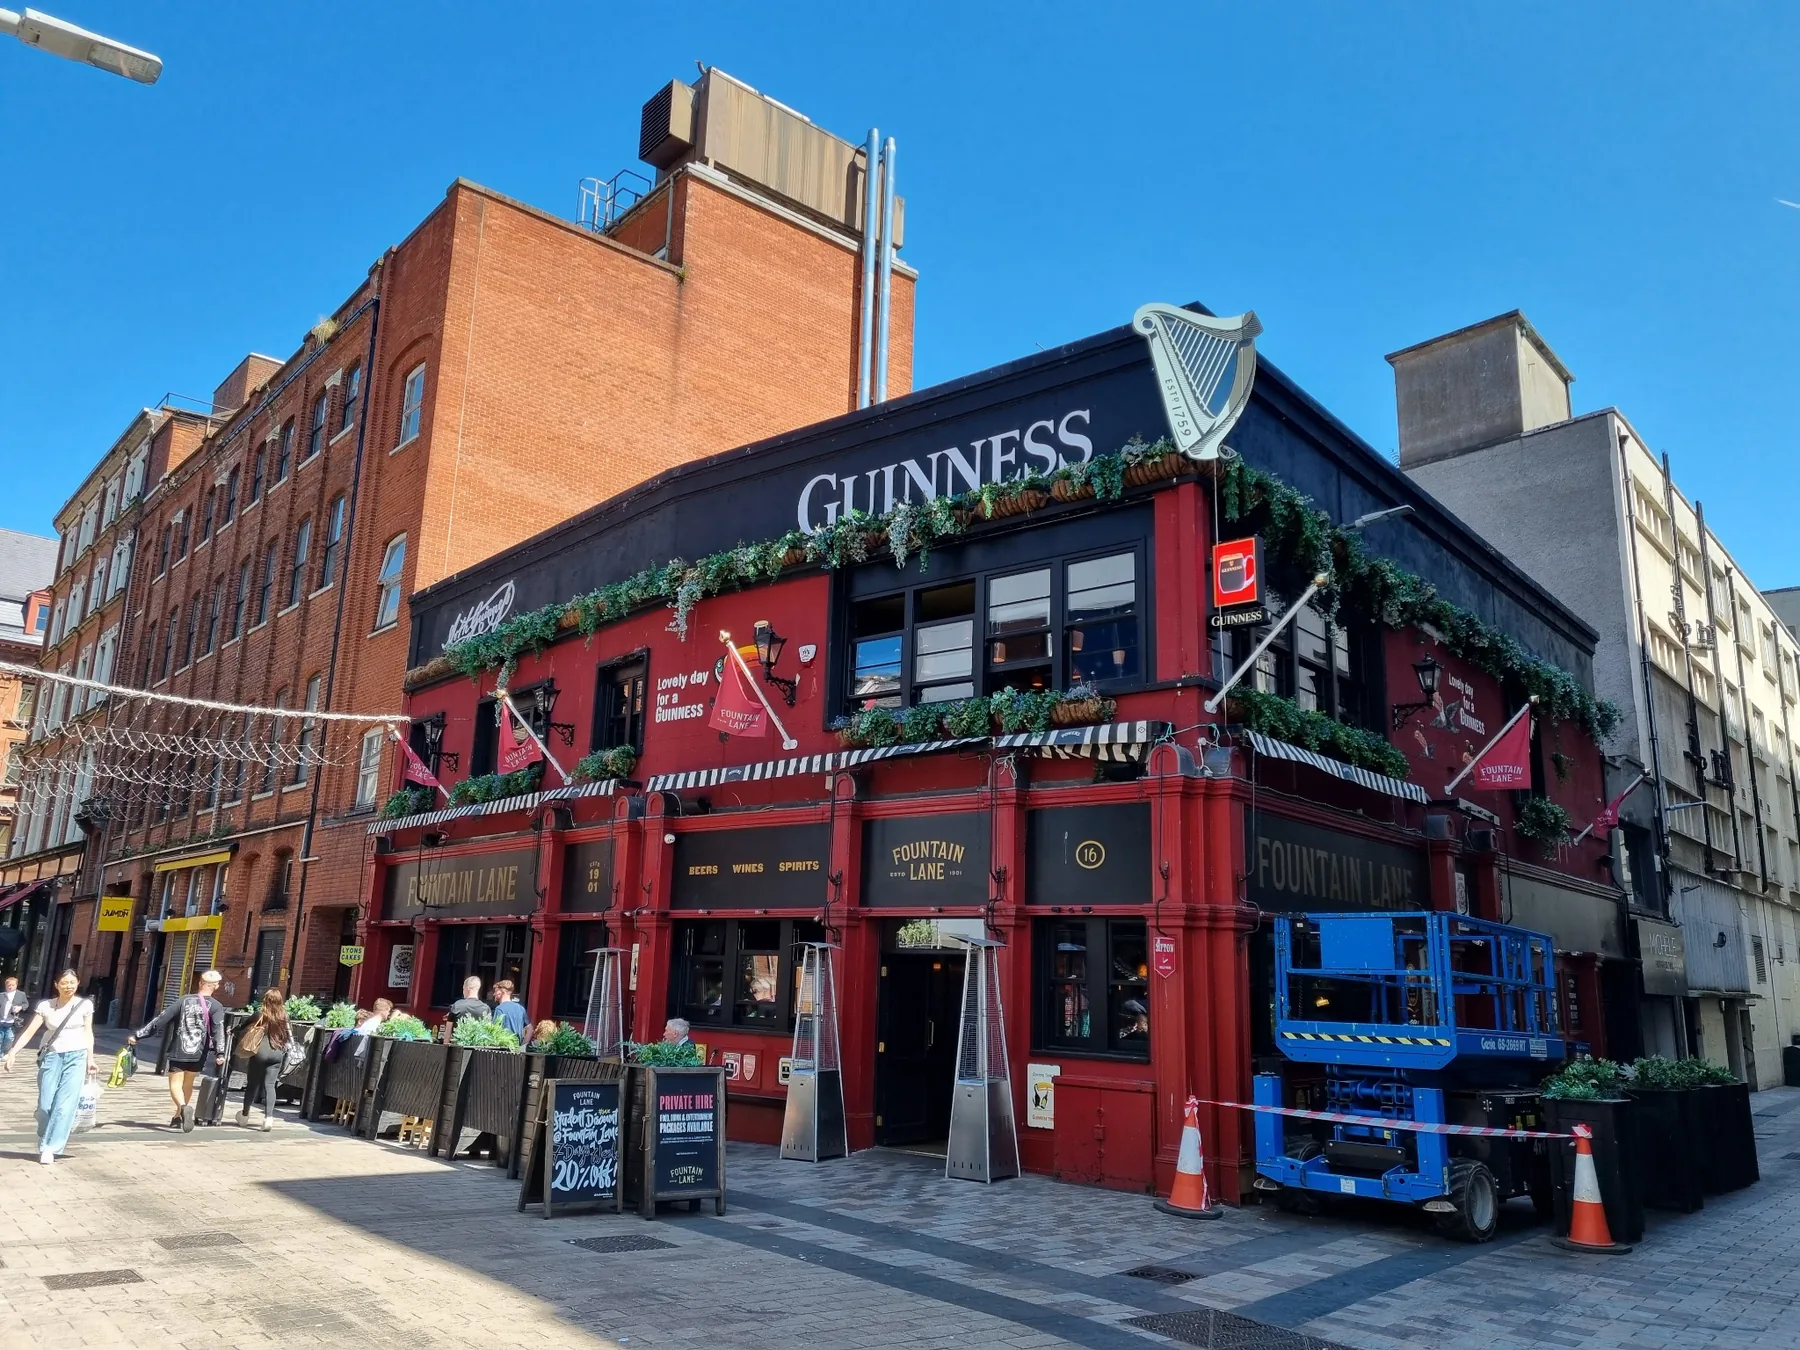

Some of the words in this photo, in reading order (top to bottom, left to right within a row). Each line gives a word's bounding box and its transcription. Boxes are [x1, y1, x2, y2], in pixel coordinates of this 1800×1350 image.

[1172, 405, 1192, 437] 1759
[797, 408, 1094, 536] GUINNESS
[1221, 565, 1243, 573] GUINNESS
[1211, 610, 1262, 627] GUINNESS
[657, 673, 687, 691] Lovely
[690, 670, 709, 686] day
[1448, 673, 1466, 694] Lovely
[1465, 682, 1475, 700] day
[656, 693, 669, 707] for
[672, 693, 679, 704] a
[655, 703, 704, 724] GUINNESS
[1460, 707, 1486, 736] GUINNESS
[1480, 765, 1523, 777] FOUNTAIN
[1491, 773, 1513, 783] LANE
[892, 840, 966, 866] FOUNTAIN
[1084, 847, 1098, 863] 16
[589, 868, 600, 880] 19
[689, 865, 719, 876] BEERS
[732, 862, 765, 874] WINES
[779, 860, 820, 872] SPIRITS
[909, 863, 945, 881] LANE
[1257, 836, 1363, 904] FOUNTAIN
[1367, 860, 1417, 912] LANE
[476, 865, 518, 902] LANE
[587, 881, 598, 893] 01
[573, 1091, 601, 1100] FOUNTAIN
[660, 1095, 693, 1111] PRIVATE
[695, 1094, 713, 1109] HIRE
[553, 1106, 593, 1131] Student
[585, 1107, 619, 1128] Discount
[660, 1121, 687, 1134] PACKAGES
[687, 1120, 713, 1133] AVAILABLE
[670, 1166, 704, 1178] FOUNTAIN
[678, 1175, 696, 1184] LANE
